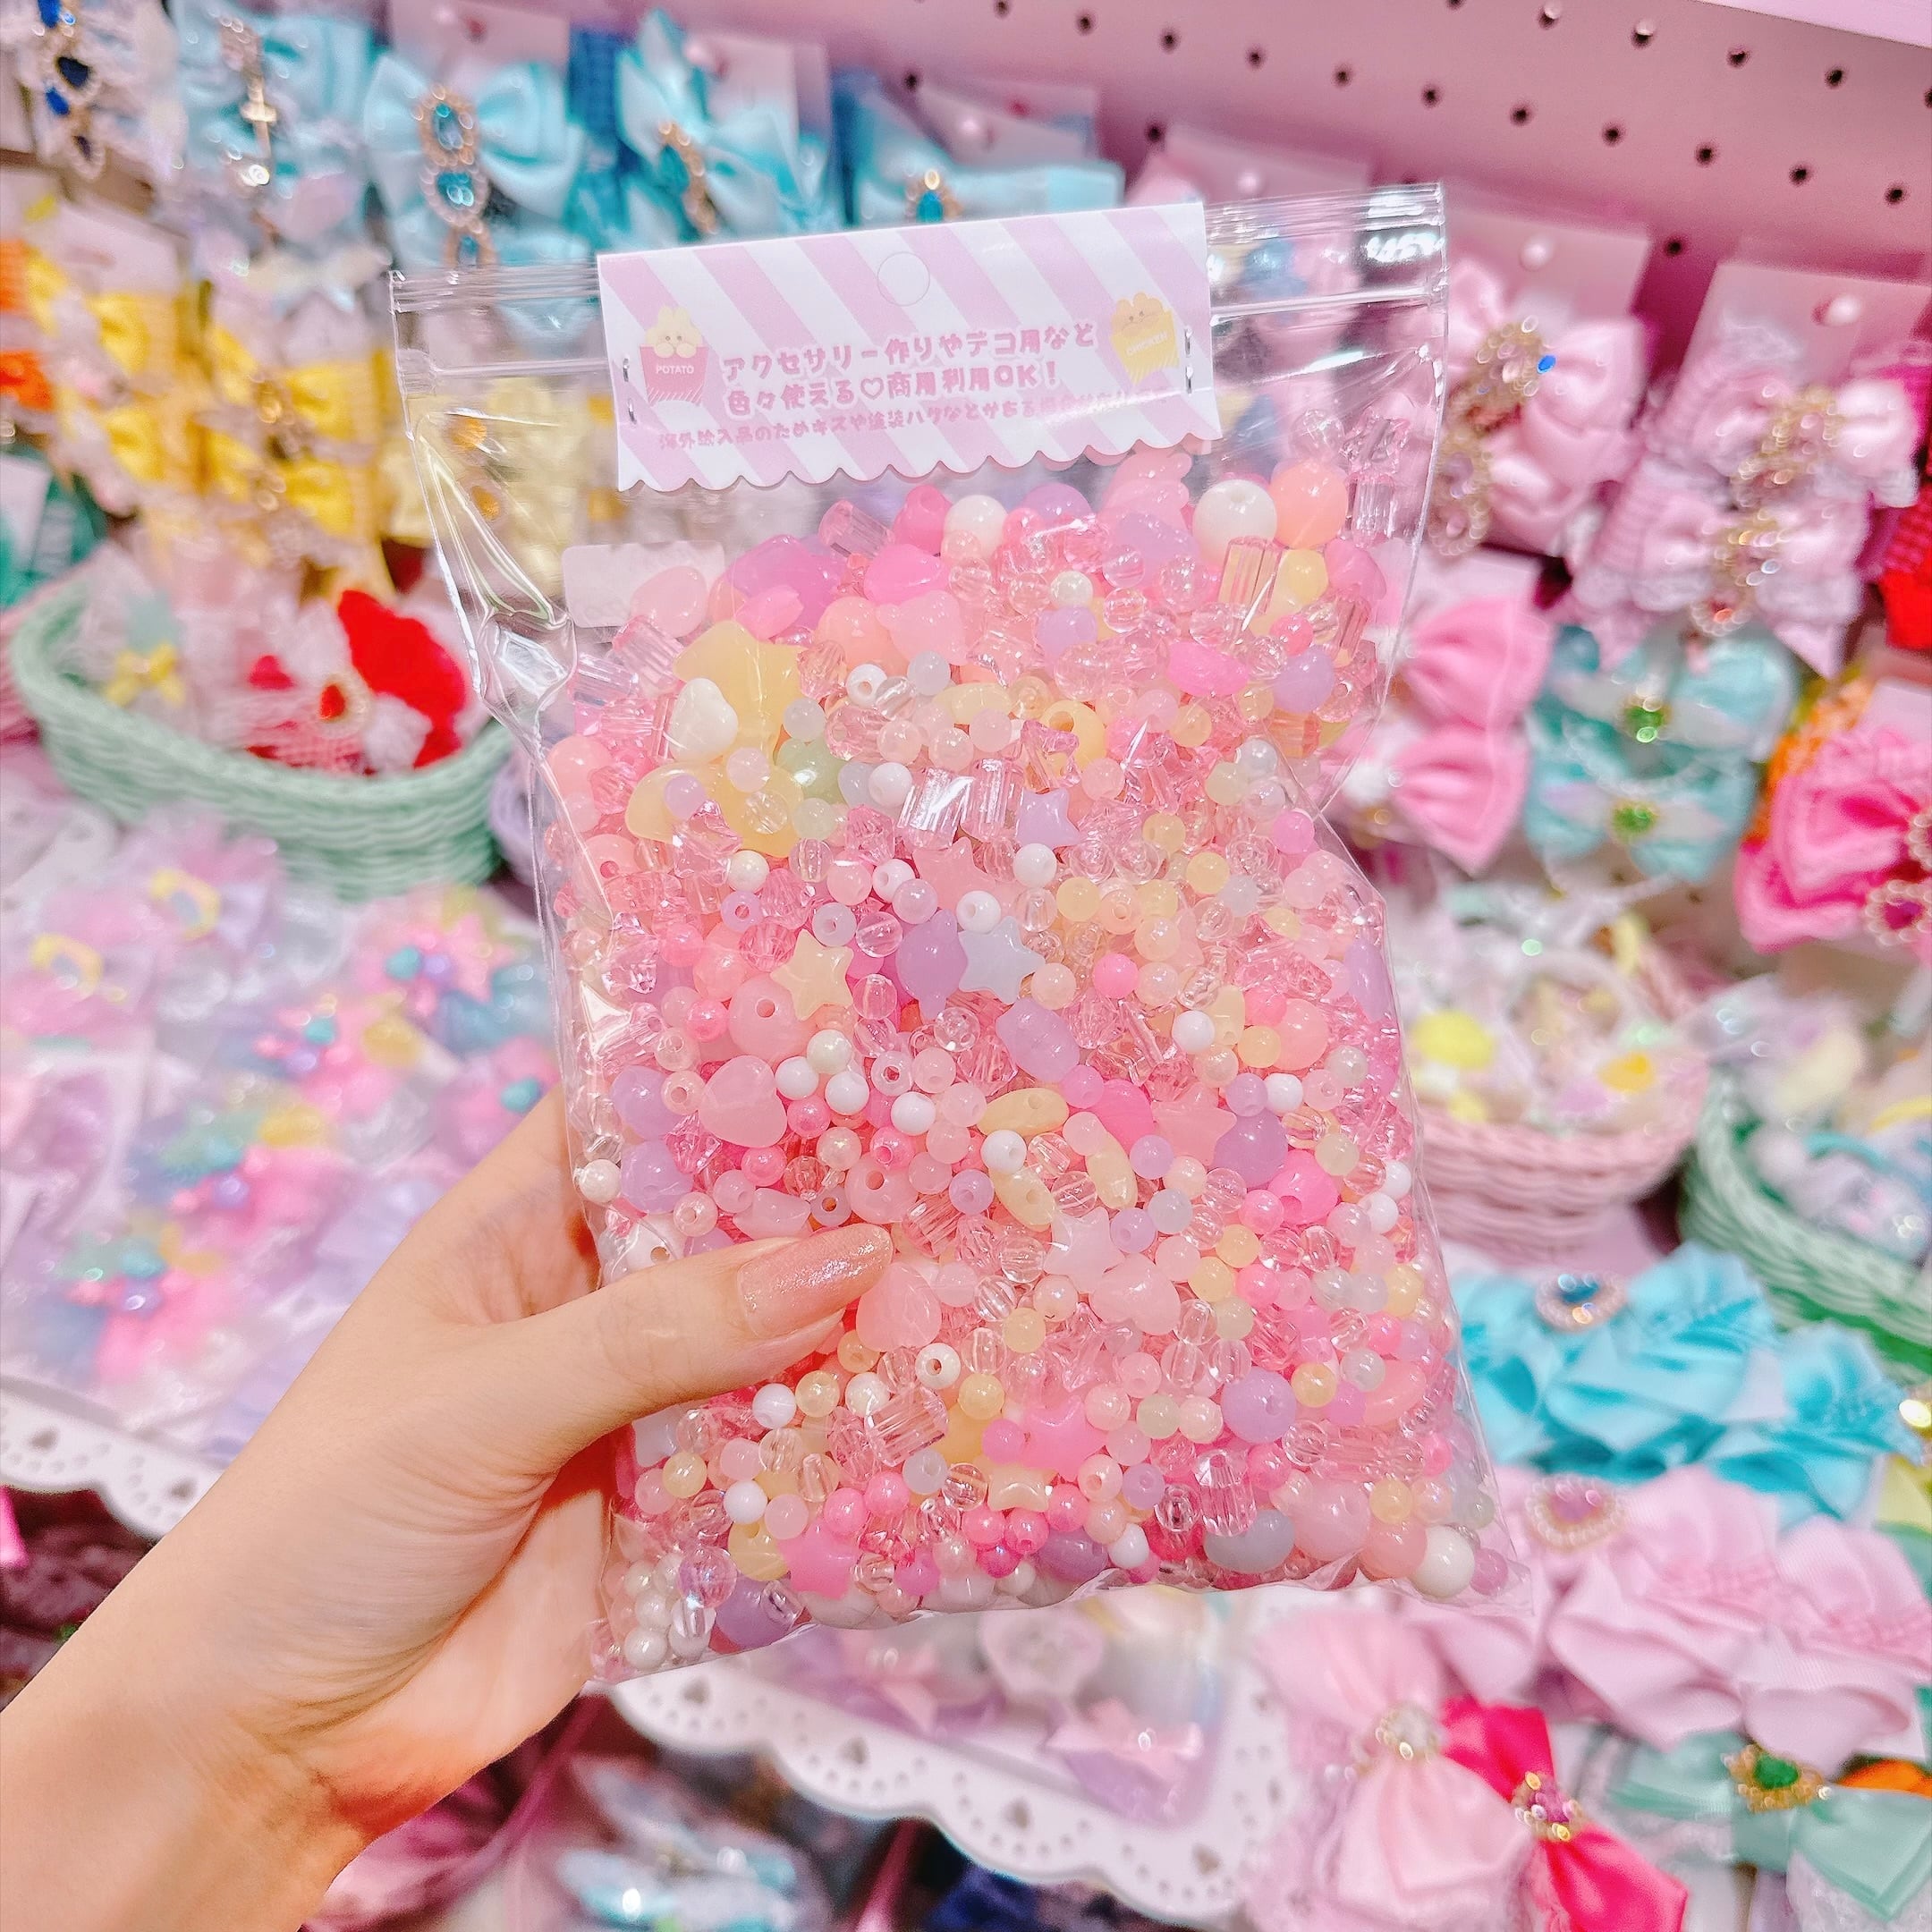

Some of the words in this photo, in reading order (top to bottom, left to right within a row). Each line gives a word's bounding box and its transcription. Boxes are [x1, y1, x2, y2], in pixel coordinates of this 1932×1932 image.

[655, 364, 695, 375] POTATO
[723, 322, 1094, 382] アクセサリー作りやデコ用など
